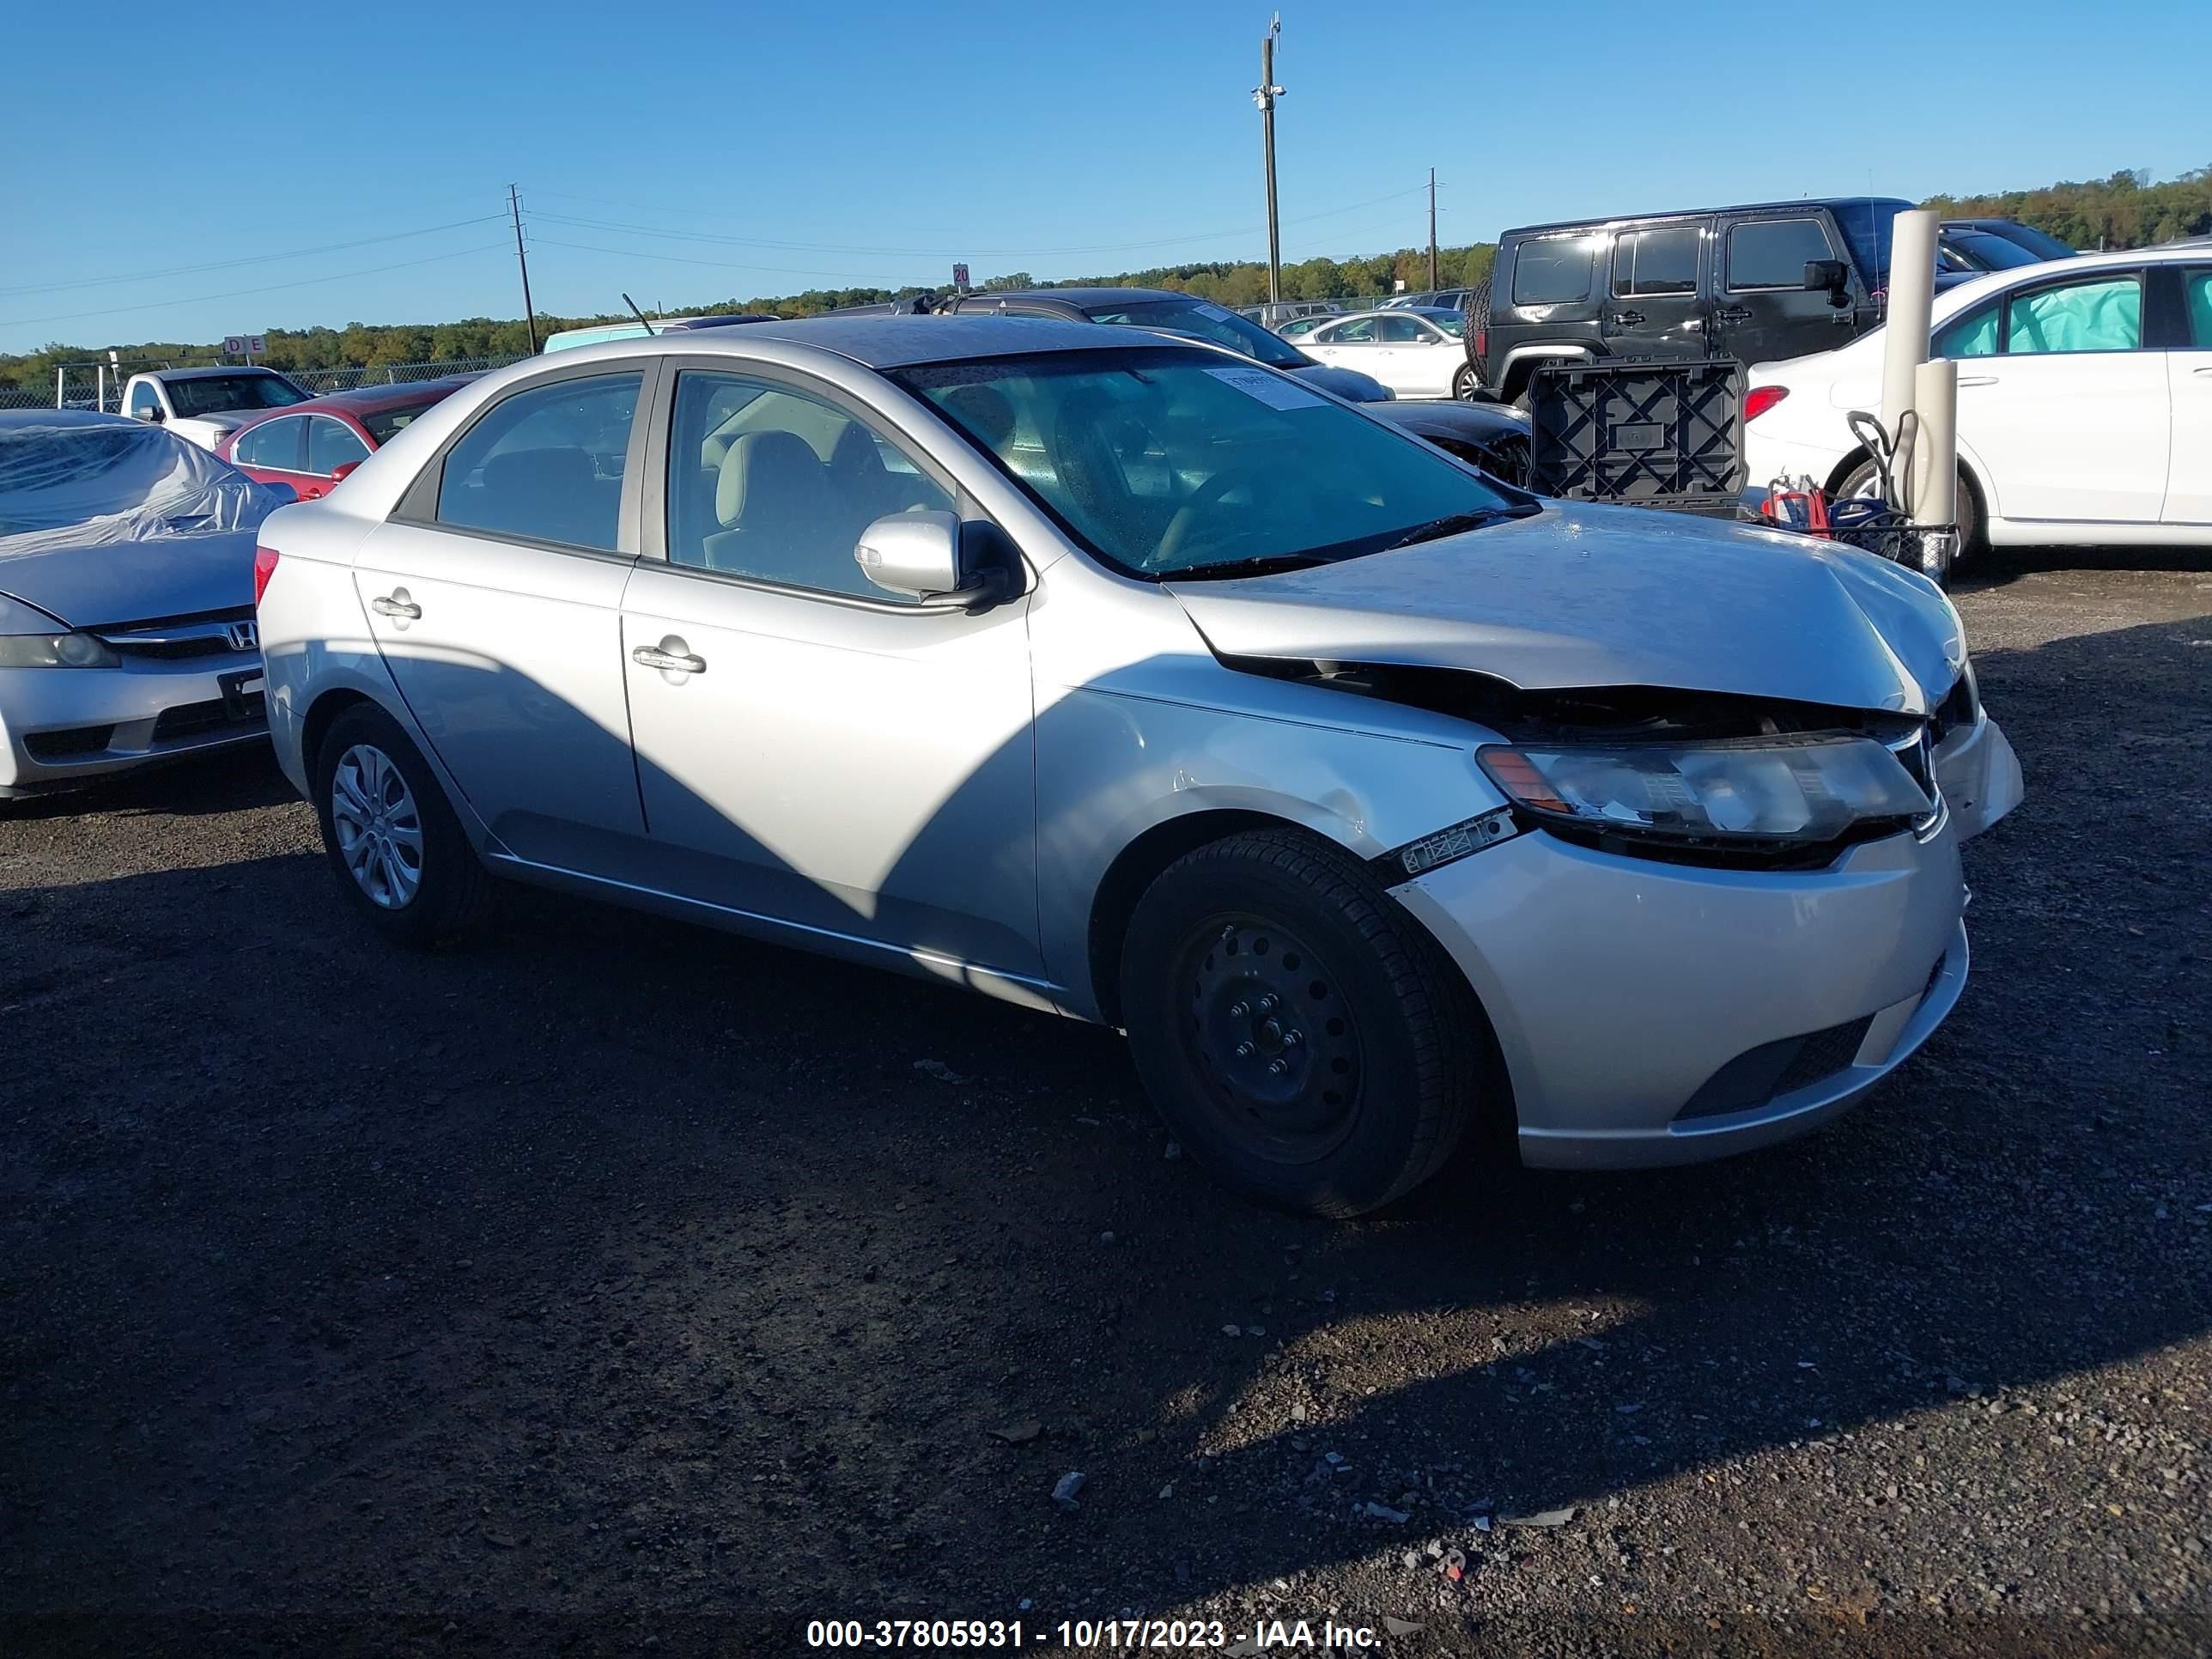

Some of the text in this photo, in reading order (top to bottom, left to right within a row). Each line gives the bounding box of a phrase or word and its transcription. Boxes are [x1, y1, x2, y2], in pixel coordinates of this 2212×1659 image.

[955, 269, 968, 282] 20
[228, 339, 240, 351] D
[252, 338, 261, 350] E
